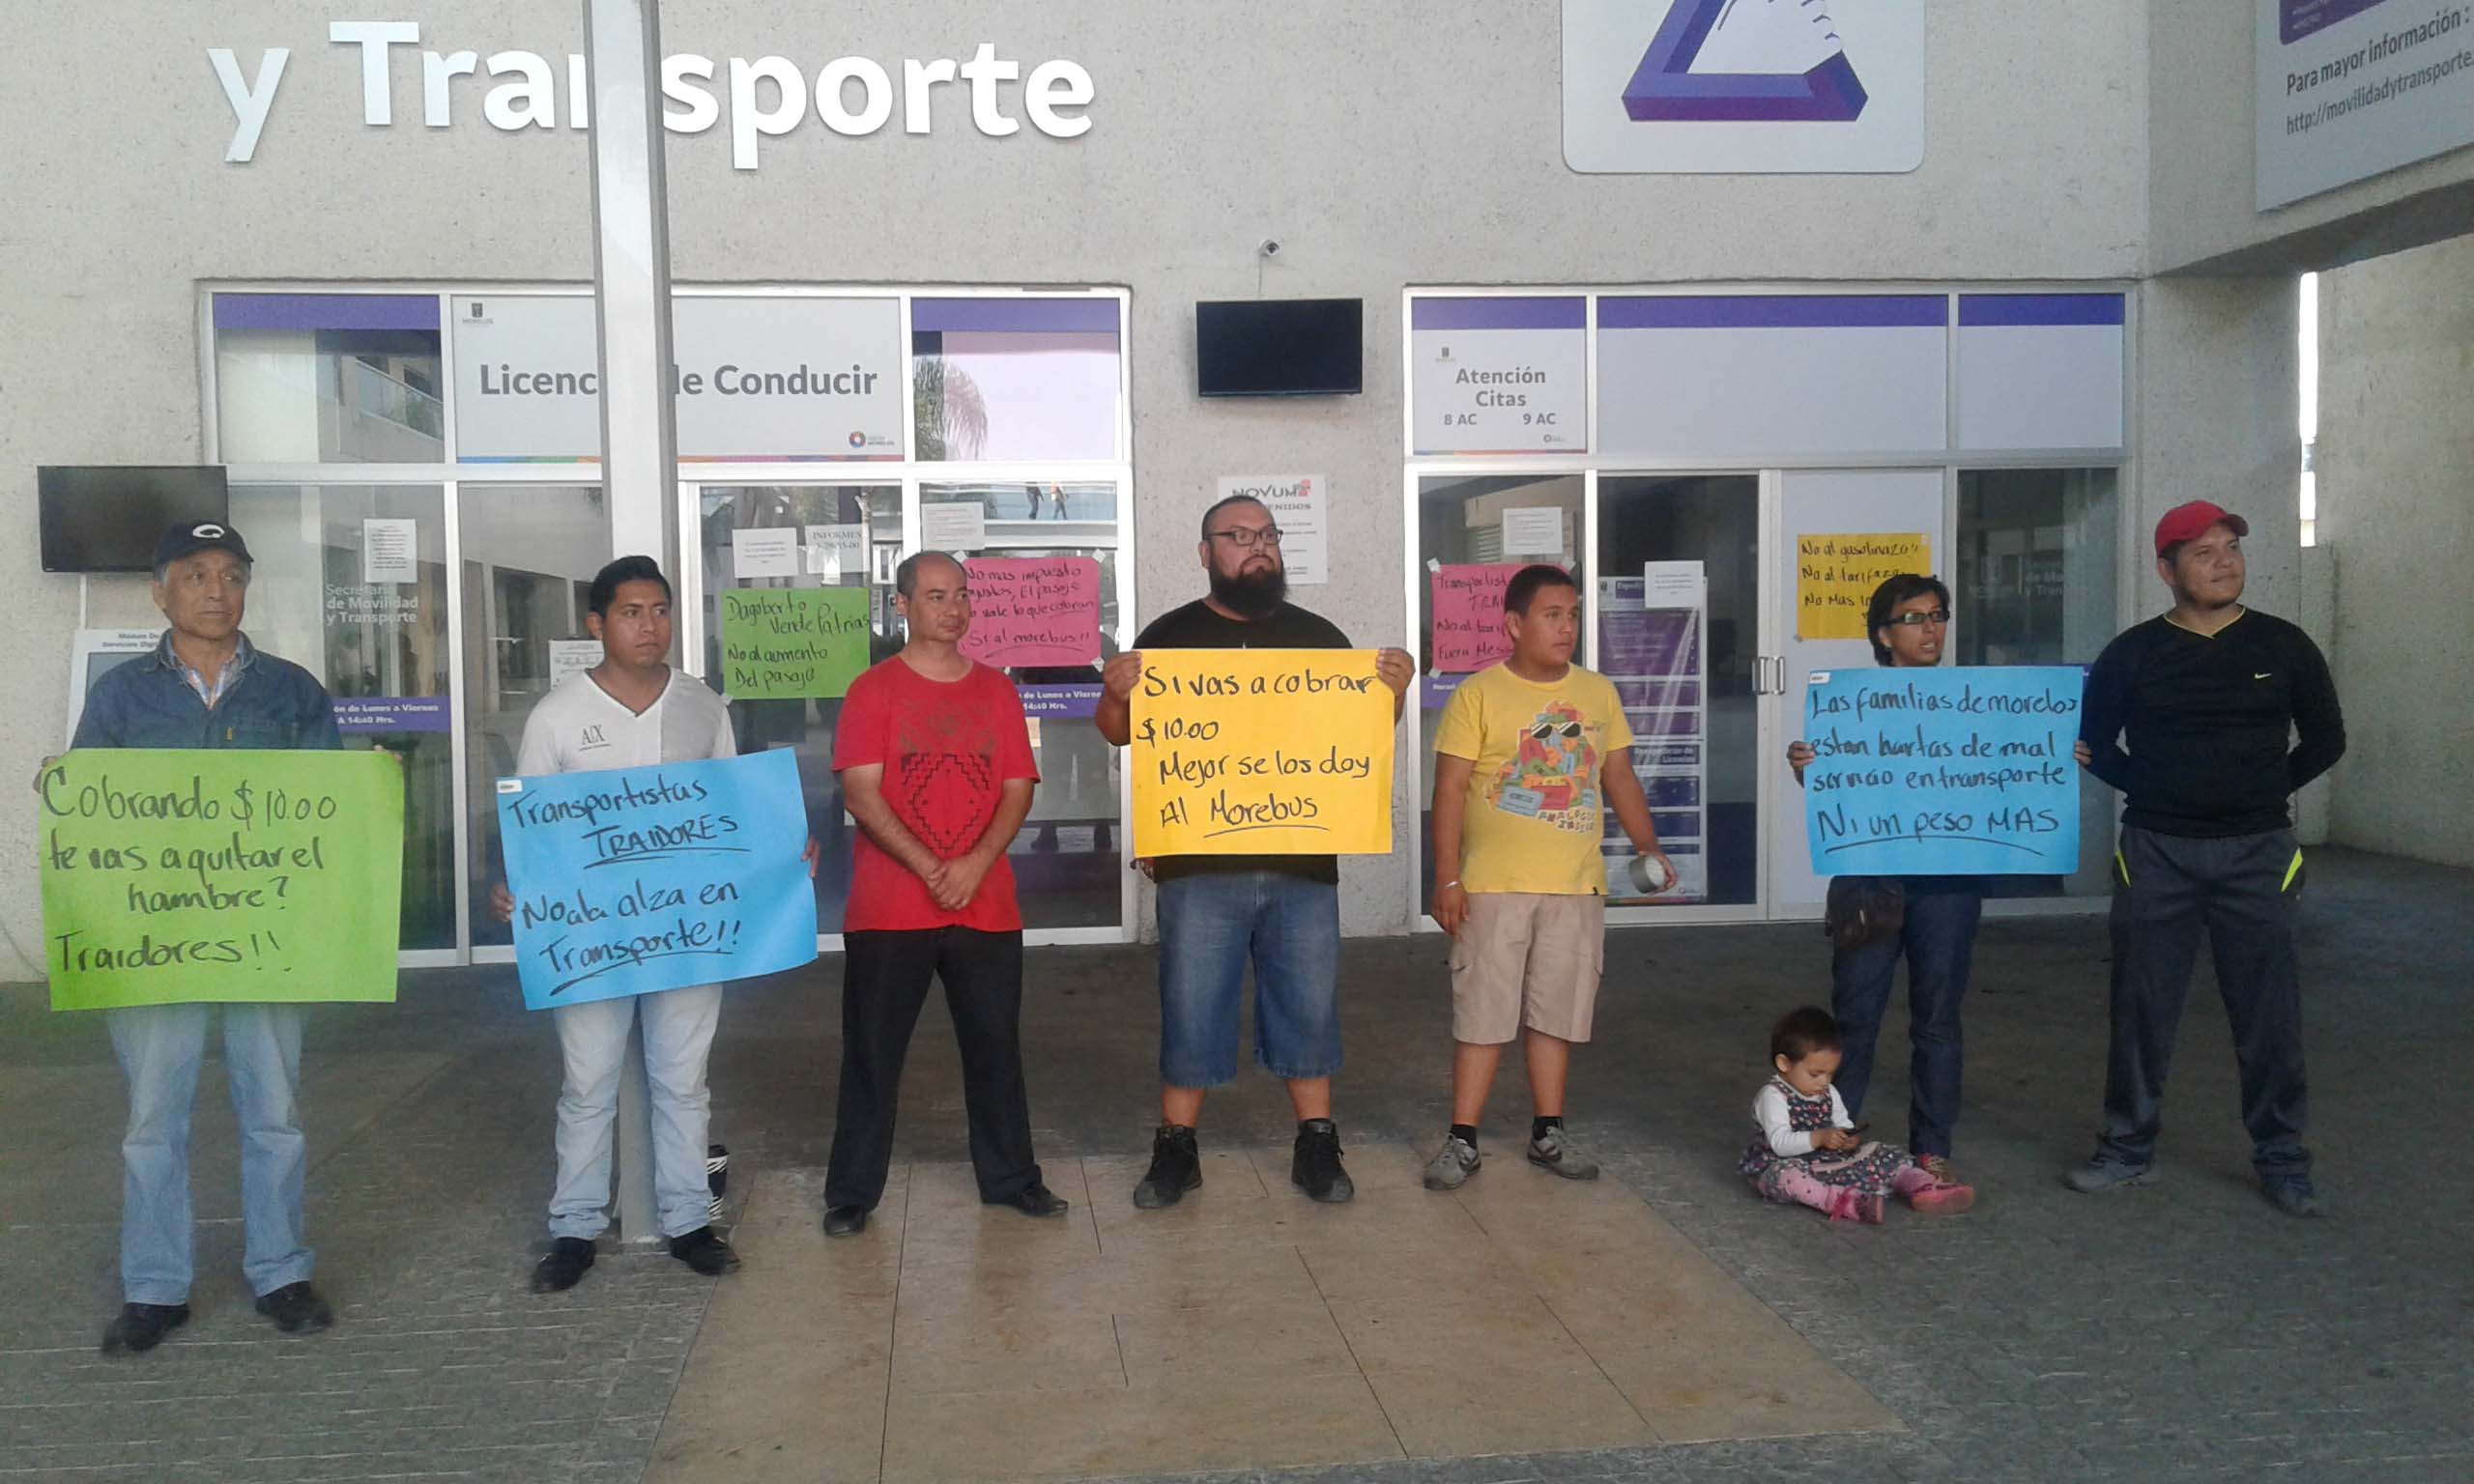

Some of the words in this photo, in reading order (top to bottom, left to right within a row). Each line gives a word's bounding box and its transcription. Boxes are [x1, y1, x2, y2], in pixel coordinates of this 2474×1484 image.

[2287, 70, 2317, 97] Para
[2321, 48, 2366, 83] mayor
[208, 46, 291, 162] y
[329, 21, 1095, 169] Trasporte
[480, 363, 597, 396] Licenc
[713, 363, 877, 396] Conducir
[1455, 366, 1546, 385] Atención
[1476, 389, 1527, 407] Citas
[1444, 414, 1453, 425] 8
[1457, 414, 1478, 425] AC
[1522, 413, 1532, 424] 9
[1537, 413, 1557, 424] AC
[1801, 540, 1820, 556] No
[1802, 564, 1820, 580] No
[327, 596, 345, 609] de
[1804, 593, 1822, 607] No
[327, 614, 336, 626] y
[338, 611, 417, 626] Transporte
[735, 667, 758, 688] Del
[1812, 690, 1851, 719] Las
[1856, 683, 1953, 722] familias
[1961, 732, 1992, 757] de
[1999, 731, 2056, 758] mal
[1159, 751, 1229, 788] Mejor
[1238, 756, 1268, 776] se
[1276, 750, 1311, 775] los
[1319, 745, 1370, 778] doy
[43, 766, 220, 819] Cobrando
[507, 773, 707, 828] Transportistas
[1161, 796, 1189, 828] Al
[1211, 789, 1318, 824] Morebus
[582, 813, 738, 858] TRAIDORES
[1817, 803, 1857, 842] Ni
[1870, 811, 1903, 837] un
[1913, 812, 1972, 843] peso
[1988, 807, 2058, 834] MAS
[48, 828, 76, 870] te
[618, 877, 685, 917] alza
[700, 880, 738, 904] en
